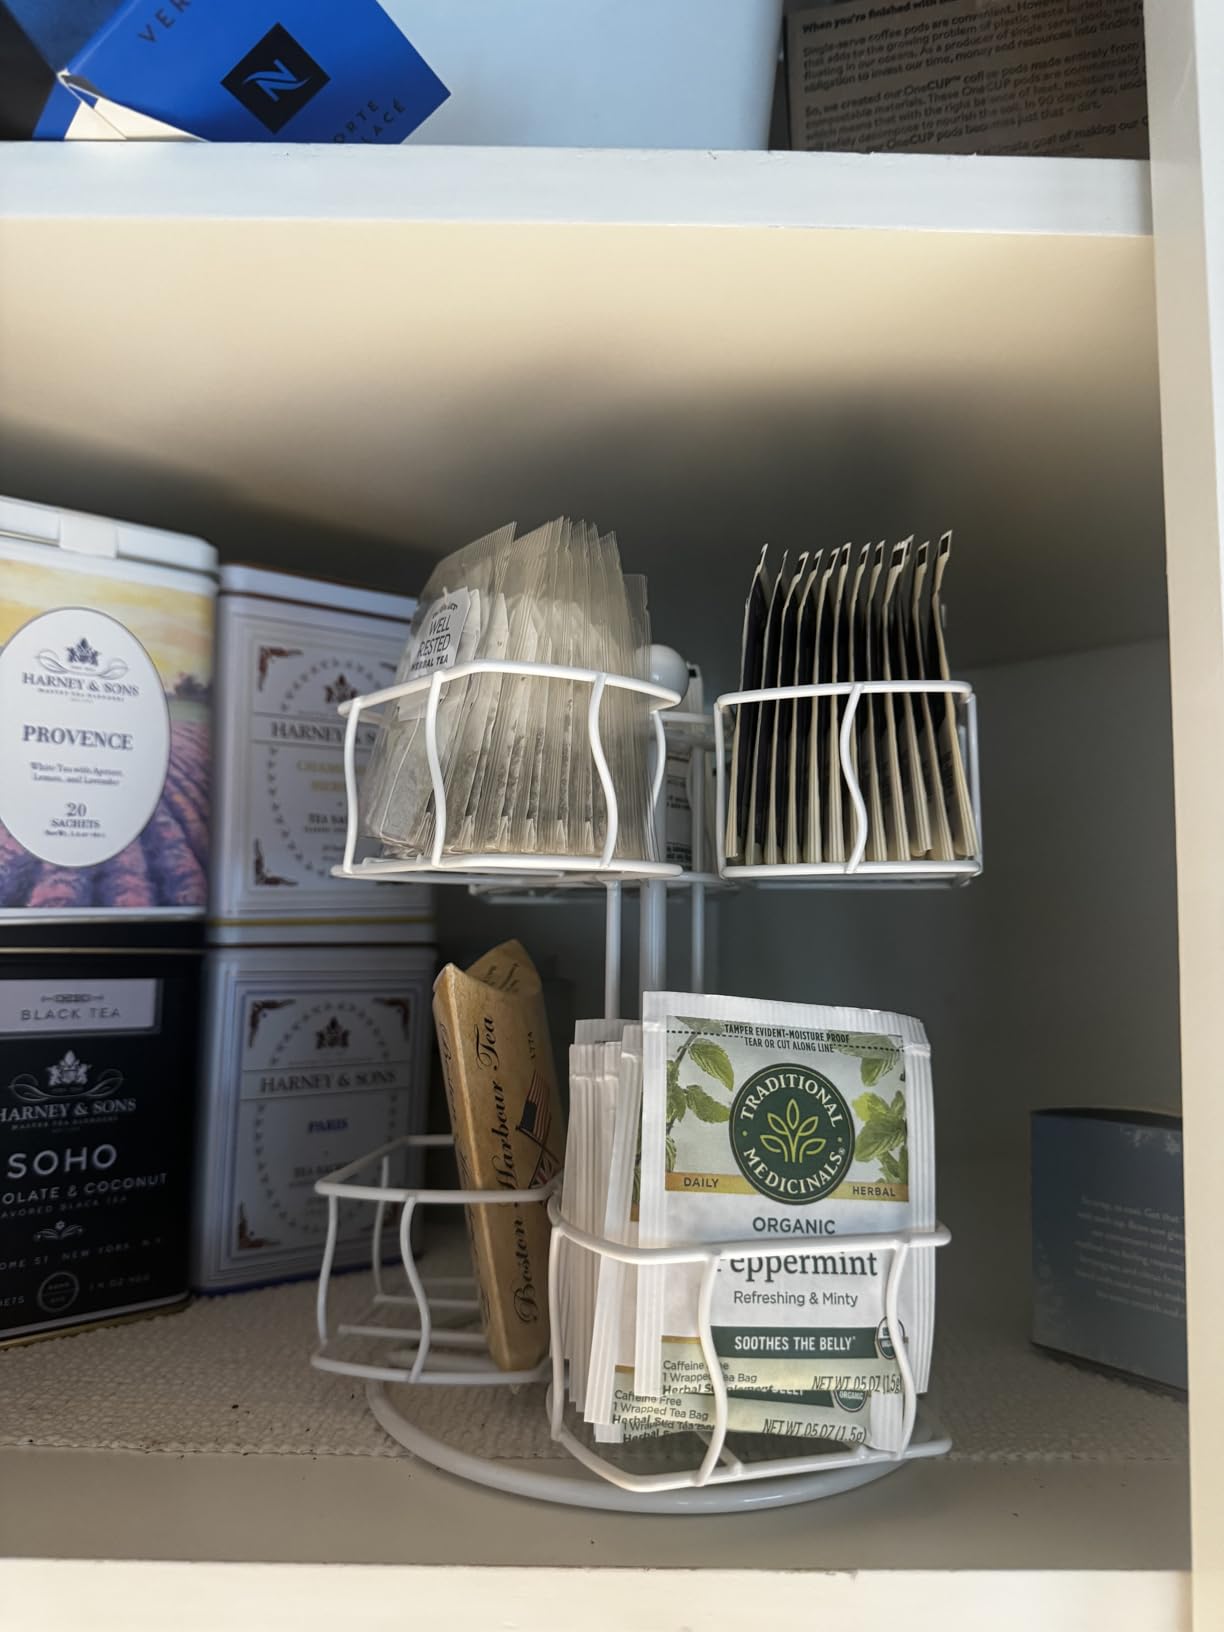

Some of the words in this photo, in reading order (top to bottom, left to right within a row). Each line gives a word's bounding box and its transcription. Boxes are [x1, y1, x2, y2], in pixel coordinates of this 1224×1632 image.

[903, 21, 930, 37] pods
[429, 615, 451, 636] WELL
[417, 634, 451, 658] RESTED
[436, 654, 448, 665] TEA
[22, 672, 85, 690] HARNEY
[88, 682, 100, 692] &
[103, 682, 140, 697] SONS
[22, 725, 133, 751] PROVENCE
[271, 721, 346, 742] HARNEY
[66, 801, 87, 817] 20
[50, 818, 101, 829] SACHETS
[21, 1008, 81, 1021] BLACK
[89, 1007, 121, 1019] TEA
[724, 1023, 754, 1036] TAMPER
[756, 1026, 825, 1042] EVIDENT-MOISTURE
[826, 1032, 850, 1044] PROOF
[474, 1015, 500, 1071] Tea
[744, 1036, 763, 1048] TEAR
[765, 1037, 775, 1048] OR
[777, 1038, 791, 1050] CUT
[793, 1040, 815, 1052] ALONG
[817, 1042, 834, 1053] LINE
[261, 1071, 333, 1093] HARNEY
[338, 1072, 351, 1088] &
[355, 1070, 397, 1085] SONS
[741, 1073, 844, 1128] TRADITIONAL
[0, 1102, 71, 1122] HARNEY
[74, 1102, 89, 1116] &
[93, 1098, 137, 1115] SONS
[307, 1118, 349, 1134] PARIS
[7, 1143, 118, 1179] SOHO
[743, 1147, 842, 1194] MEDICINALS
[67, 1185, 78, 1197] &
[84, 1173, 168, 1195] COCONUT
[683, 1176, 719, 1189] DAILY
[852, 1186, 896, 1198] HERBAL
[753, 1216, 836, 1235] ORGANIC
[512, 1217, 539, 1322] Boston
[717, 1250, 878, 1283] eppermint
[733, 1290, 805, 1307] Refreshing
[809, 1292, 819, 1305] &
[823, 1292, 858, 1308] Minty
[734, 1335, 789, 1351] SOOTHES
[793, 1336, 816, 1351] THE
[663, 1360, 704, 1371] Caffeine
[738, 1373, 757, 1383] Bag
[812, 1376, 834, 1391] NET
[662, 1384, 701, 1395] Herbal
[839, 1391, 864, 1400] ORGANIC
[660, 1396, 682, 1406] Free
[621, 1403, 667, 1416] Wrapped
[670, 1408, 687, 1418] Tea
[689, 1410, 709, 1421] Bag
[762, 1418, 785, 1434] NET
